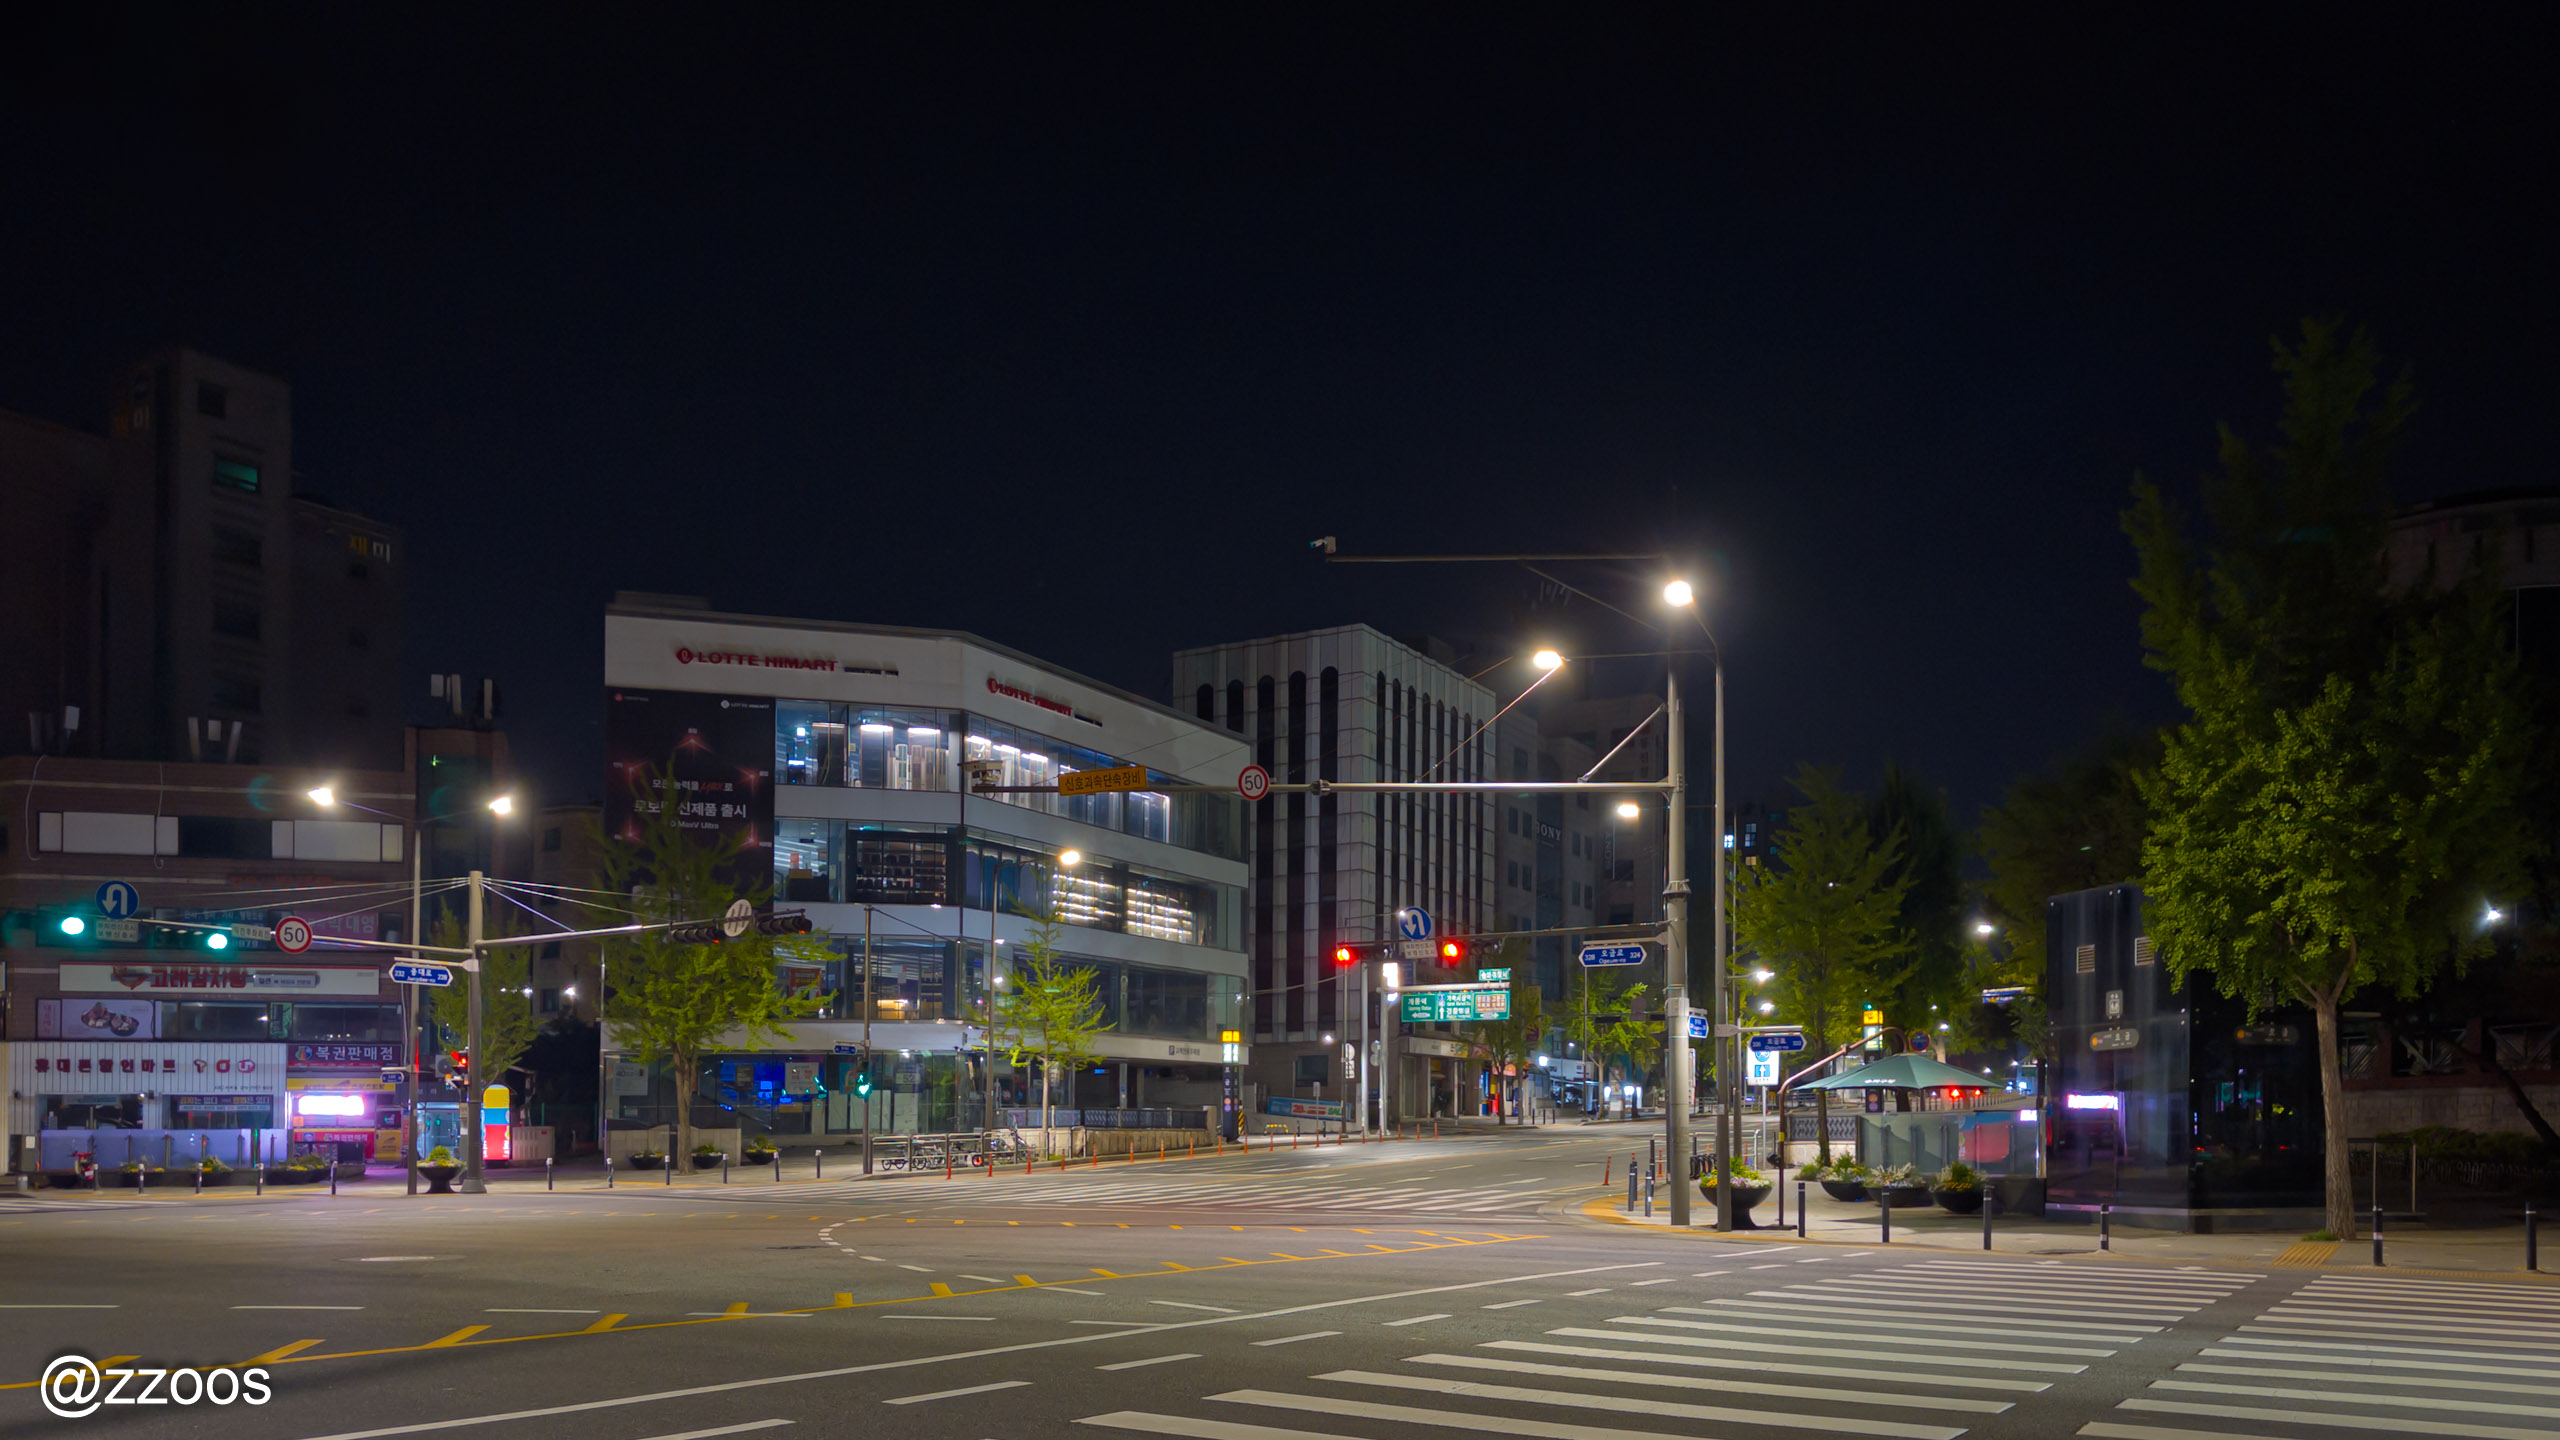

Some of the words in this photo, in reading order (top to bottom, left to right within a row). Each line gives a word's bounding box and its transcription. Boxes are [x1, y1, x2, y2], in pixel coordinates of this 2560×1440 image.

[698, 651, 760, 666] LOTTE
[765, 655, 838, 672] HIMART
[998, 683, 1033, 704] LOTTE
[1033, 695, 1073, 717] HIMART
[1065, 771, 1141, 791] 신호과속단속장비
[1245, 775, 1262, 791] 50
[680, 801, 718, 817] 신제품
[721, 803, 747, 818] 출시
[702, 821, 720, 830] Ultra
[284, 927, 305, 943] 50
[1601, 949, 1624, 957] 오금로
[411, 967, 432, 977] 중대로
[316, 1046, 393, 1060] 복권판매점
